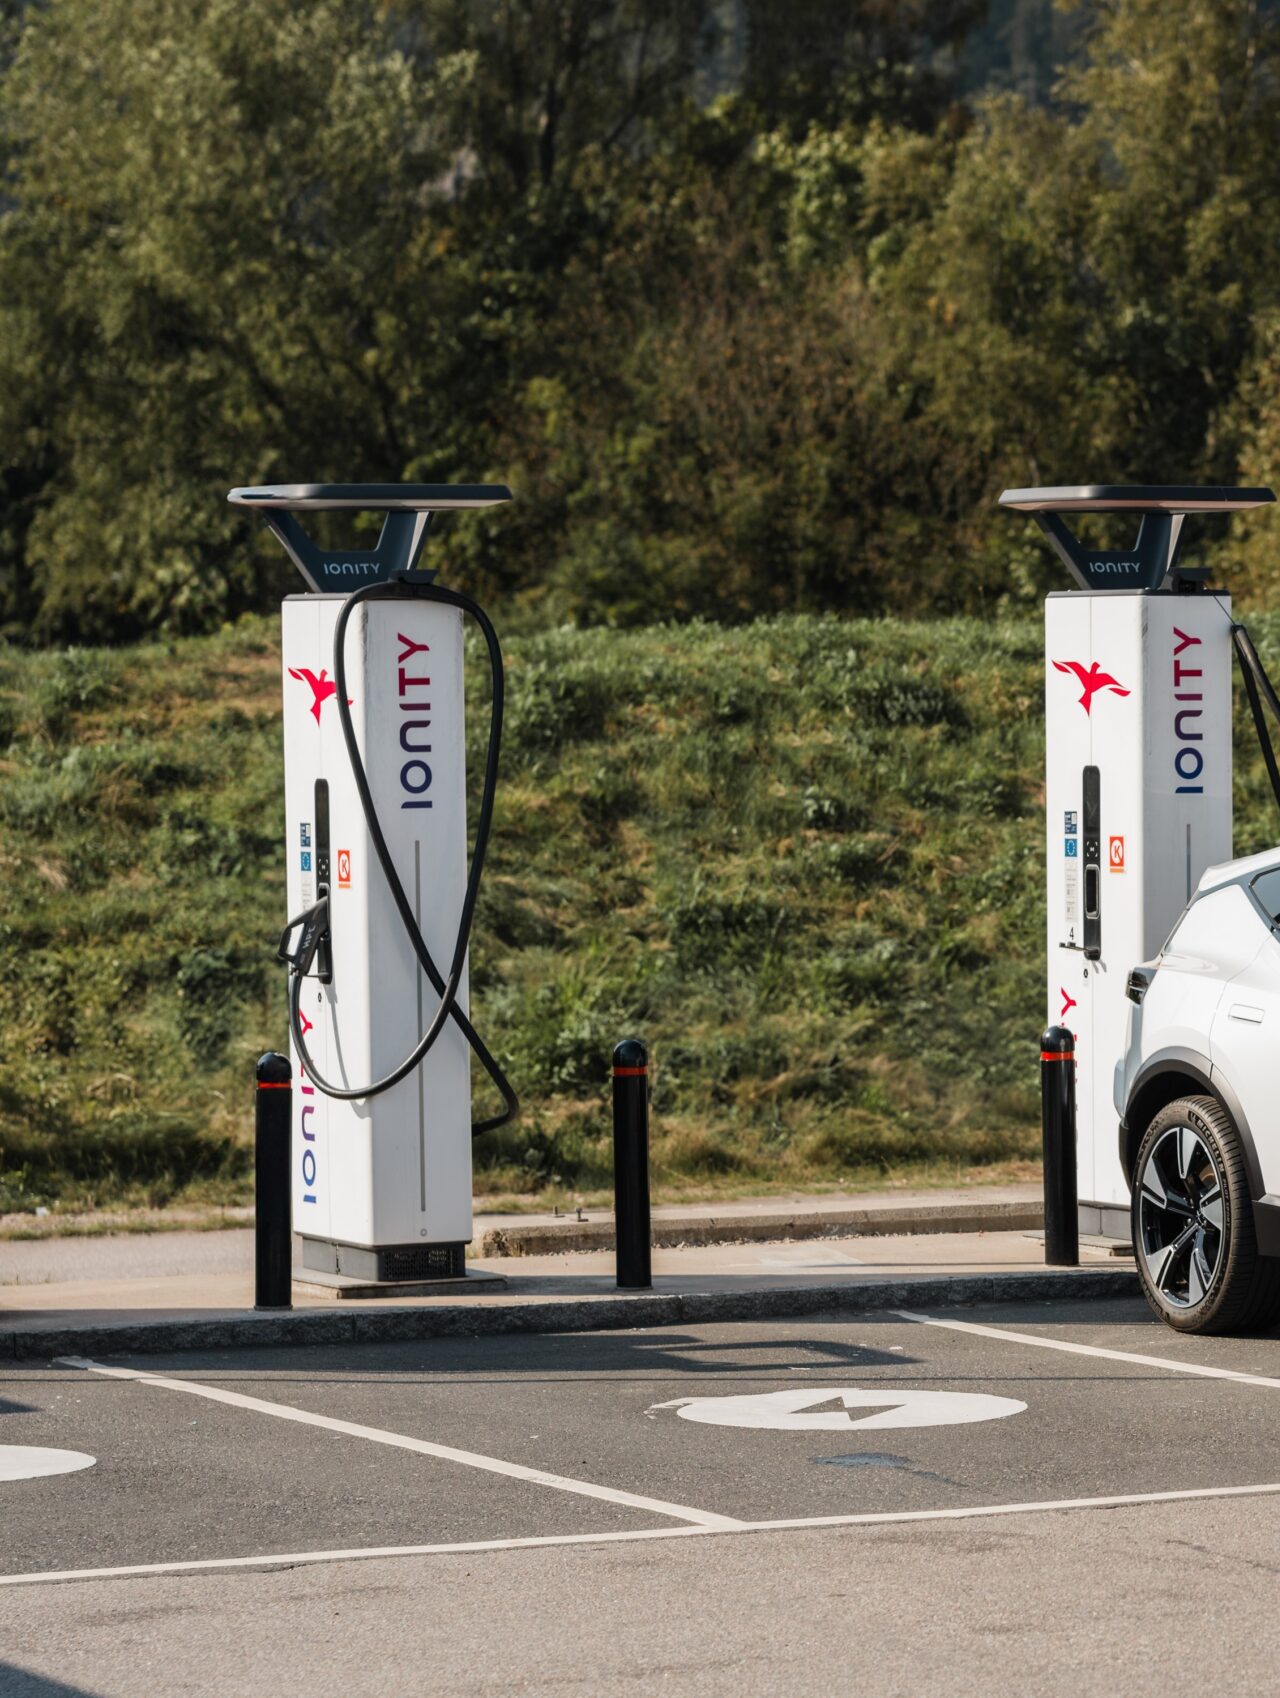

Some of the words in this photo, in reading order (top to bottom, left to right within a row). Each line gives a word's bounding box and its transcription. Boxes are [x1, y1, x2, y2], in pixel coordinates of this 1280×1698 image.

[324, 562, 380, 575] IONITY
[1089, 562, 1141, 573] IONITY
[398, 632, 433, 809] IONITY
[1173, 626, 1204, 794] IONITY
[1195, 1118, 1225, 1172] MICHELIN
